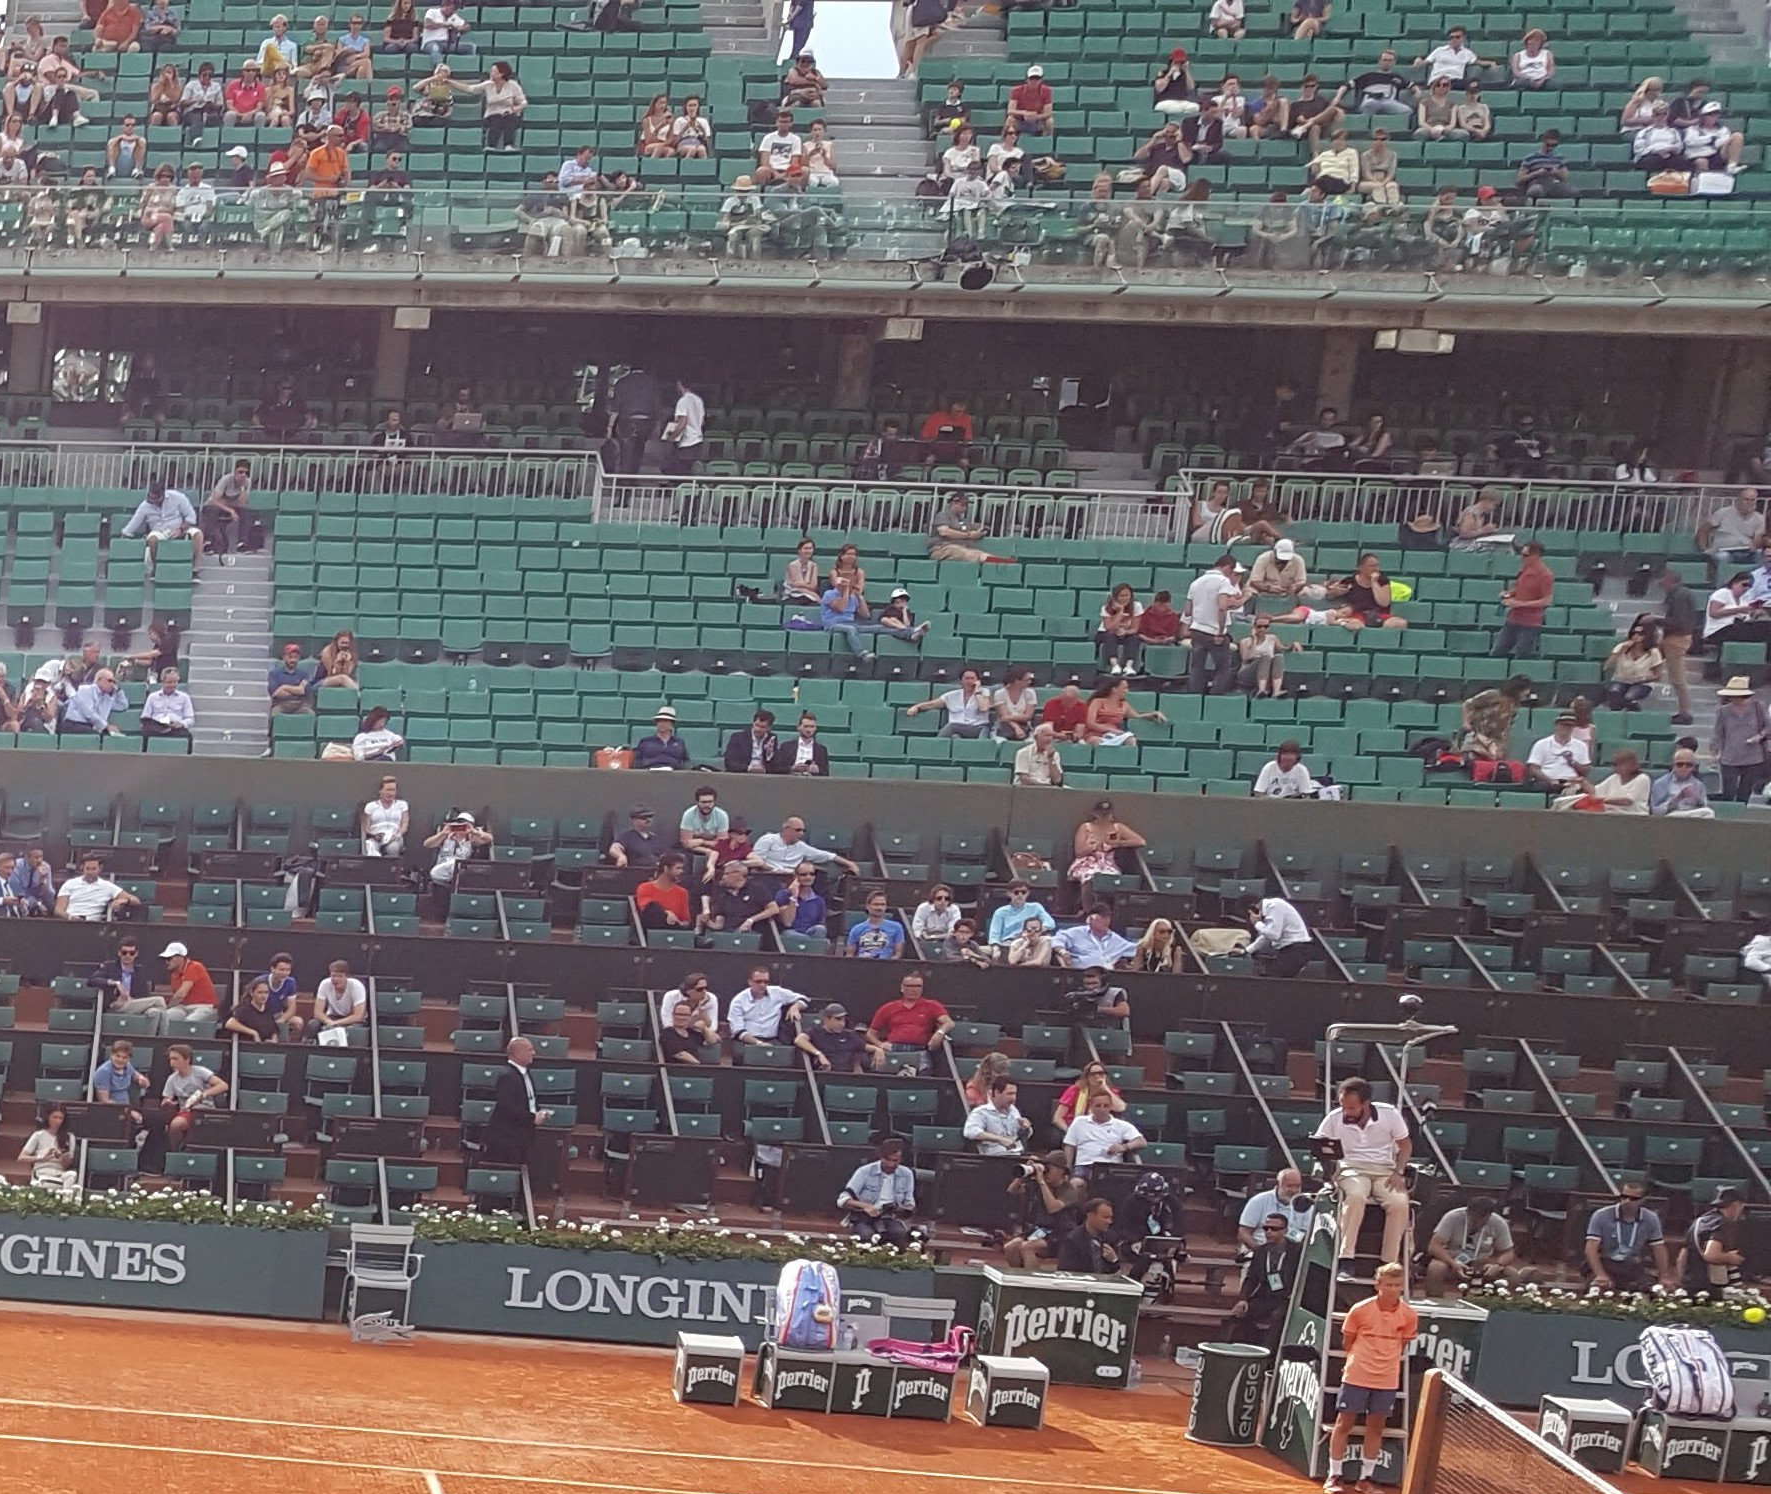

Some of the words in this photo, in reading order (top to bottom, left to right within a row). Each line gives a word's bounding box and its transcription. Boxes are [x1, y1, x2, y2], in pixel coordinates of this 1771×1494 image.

[1003, 1299, 1127, 1357] perrier
[685, 1364, 736, 1394] perrier
[774, 1369, 830, 1401] perrier
[894, 1376, 949, 1410] perrier
[988, 1389, 1042, 1417] perrier
[1570, 1429, 1623, 1459] perrier
[1663, 1435, 1722, 1469] perrier
